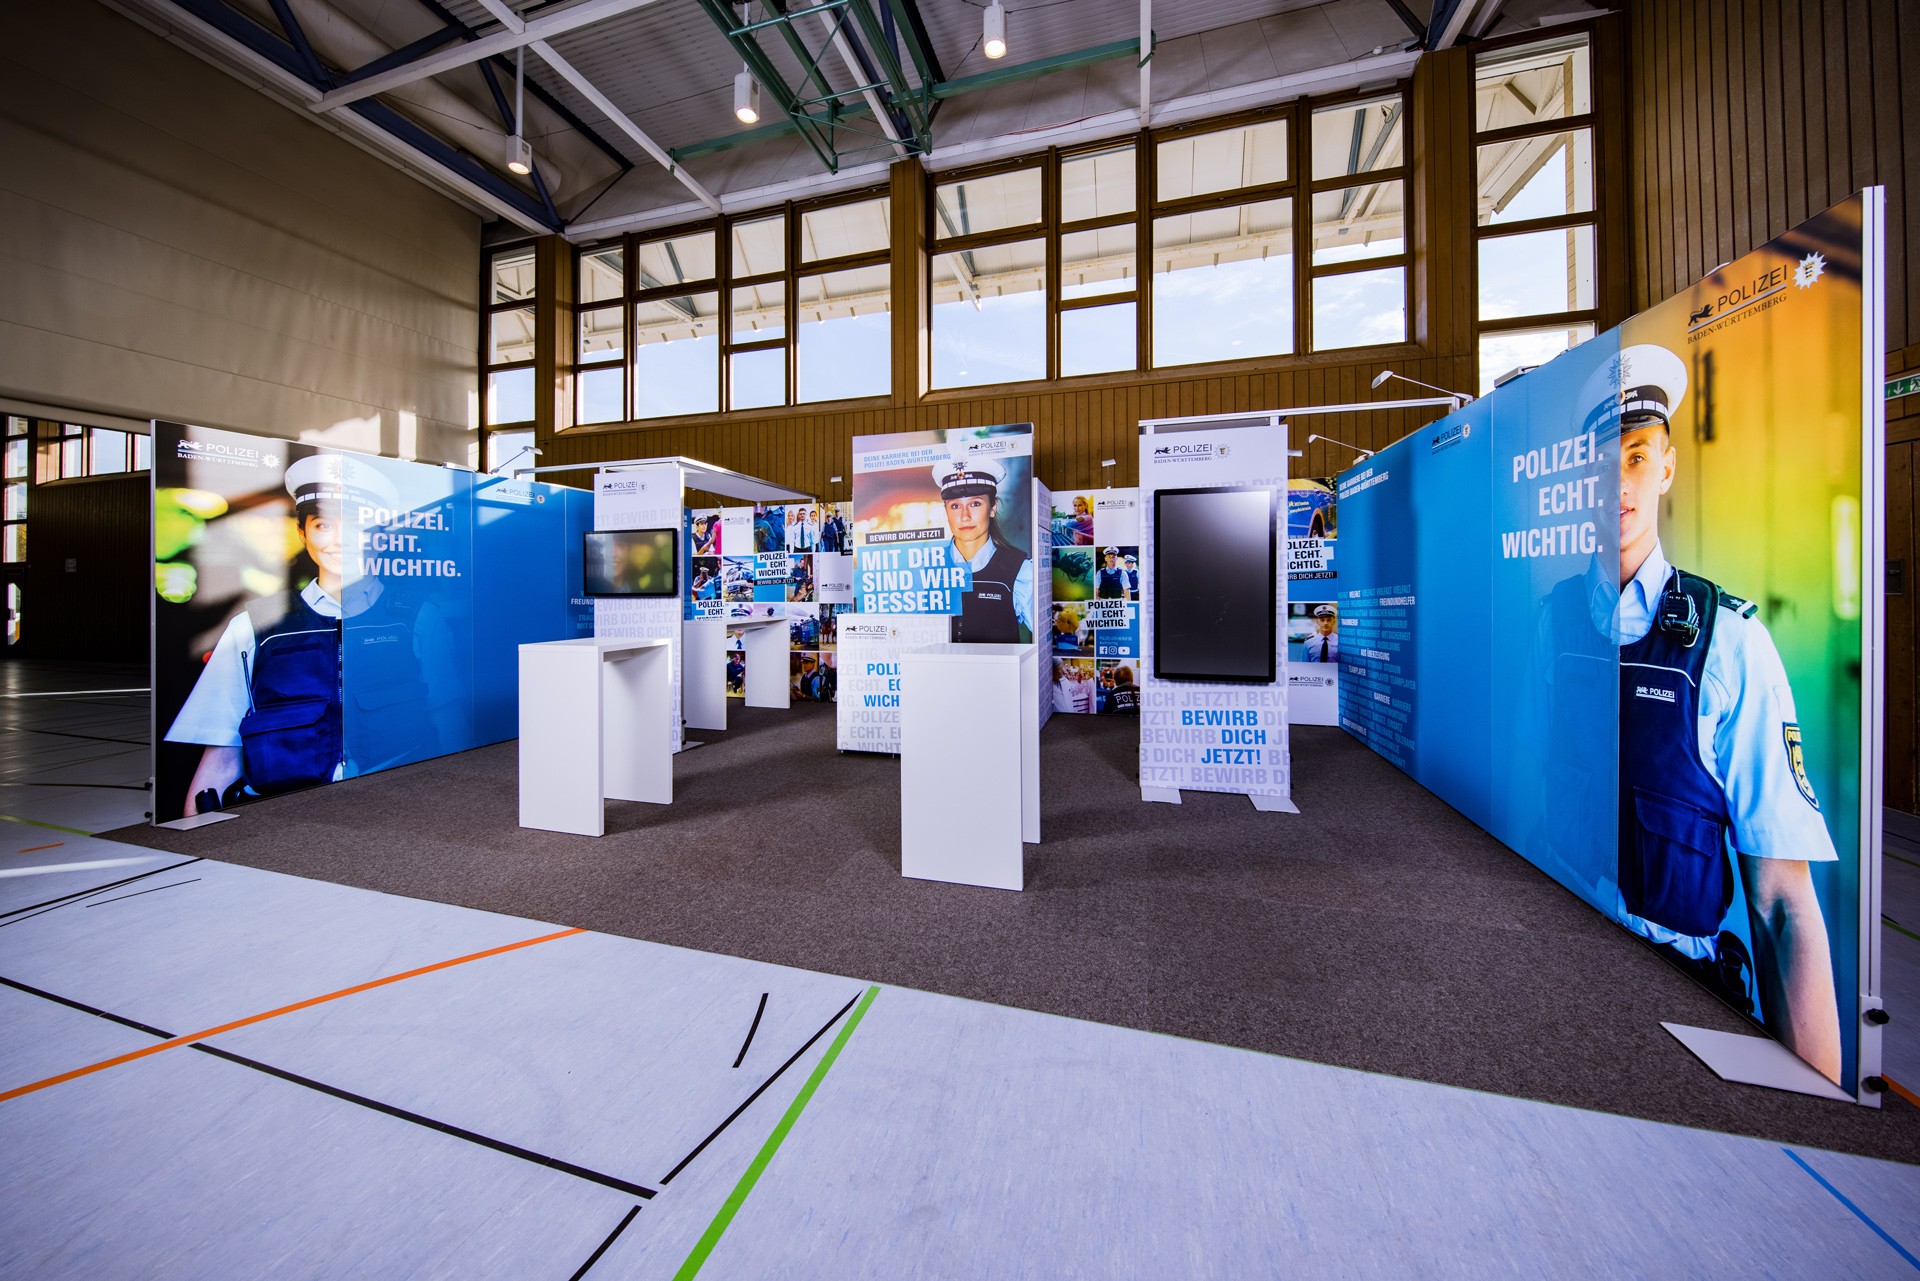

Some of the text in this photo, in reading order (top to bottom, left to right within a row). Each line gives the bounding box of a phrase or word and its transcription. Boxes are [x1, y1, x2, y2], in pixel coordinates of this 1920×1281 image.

[1717, 264, 1788, 312] POLIZEI
[1687, 292, 1787, 345] BADEN-WÜRTTEMBERG
[1440, 424, 1461, 441] POLIZEI
[206, 443, 259, 459] POLIZEI
[980, 441, 1007, 449] POLIZEI
[1173, 443, 1212, 454] POLIZEI
[863, 454, 881, 463] DEINE
[881, 452, 909, 461] KARRIERE
[910, 450, 920, 458] BEI
[864, 453, 951, 469] POLIZEI BADEN-WÜRTTEMBERG
[1513, 431, 1604, 483] POLIZEI.
[614, 481, 638, 489] POLIZEI
[509, 488, 536, 498] POLIZEI
[1539, 475, 1604, 516] ECHT.
[358, 506, 449, 531] POLIZEI.
[358, 532, 422, 552] ECHT.
[869, 530, 941, 542] BEWIRB DICH JETZT!
[1501, 521, 1604, 559] WICHTIG.
[759, 552, 787, 561] POLIZEI.
[862, 546, 946, 571] MIT DIR
[1294, 550, 1323, 559] ECHT.
[357, 557, 462, 577] WICHTIG.
[758, 568, 788, 577] WICHTIG.
[862, 567, 966, 593] SIND WIR
[1299, 572, 1314, 580] DICH
[1314, 571, 1333, 579] JETZT!
[698, 601, 725, 609] POLIZEI.
[863, 590, 951, 613] BESSER!
[1087, 601, 1126, 609] POLIZEI.
[1101, 609, 1126, 618] ECHT.
[859, 625, 888, 633] POLIZEI
[1086, 619, 1127, 628] WICHTIG.
[866, 663, 900, 675] POLI
[1115, 694, 1140, 704] POLZ
[1181, 691, 1239, 707] JETZT!
[1649, 687, 1675, 699] POLIZEI
[1181, 709, 1258, 726] BEWIRB
[849, 726, 885, 739] ECHT.
[1142, 729, 1216, 745] BEWIRB
[1221, 729, 1267, 745] DICH
[1153, 748, 1196, 763] DICH
[1201, 748, 1261, 765] JETZT!
[1191, 767, 1268, 785] BEWIRB
